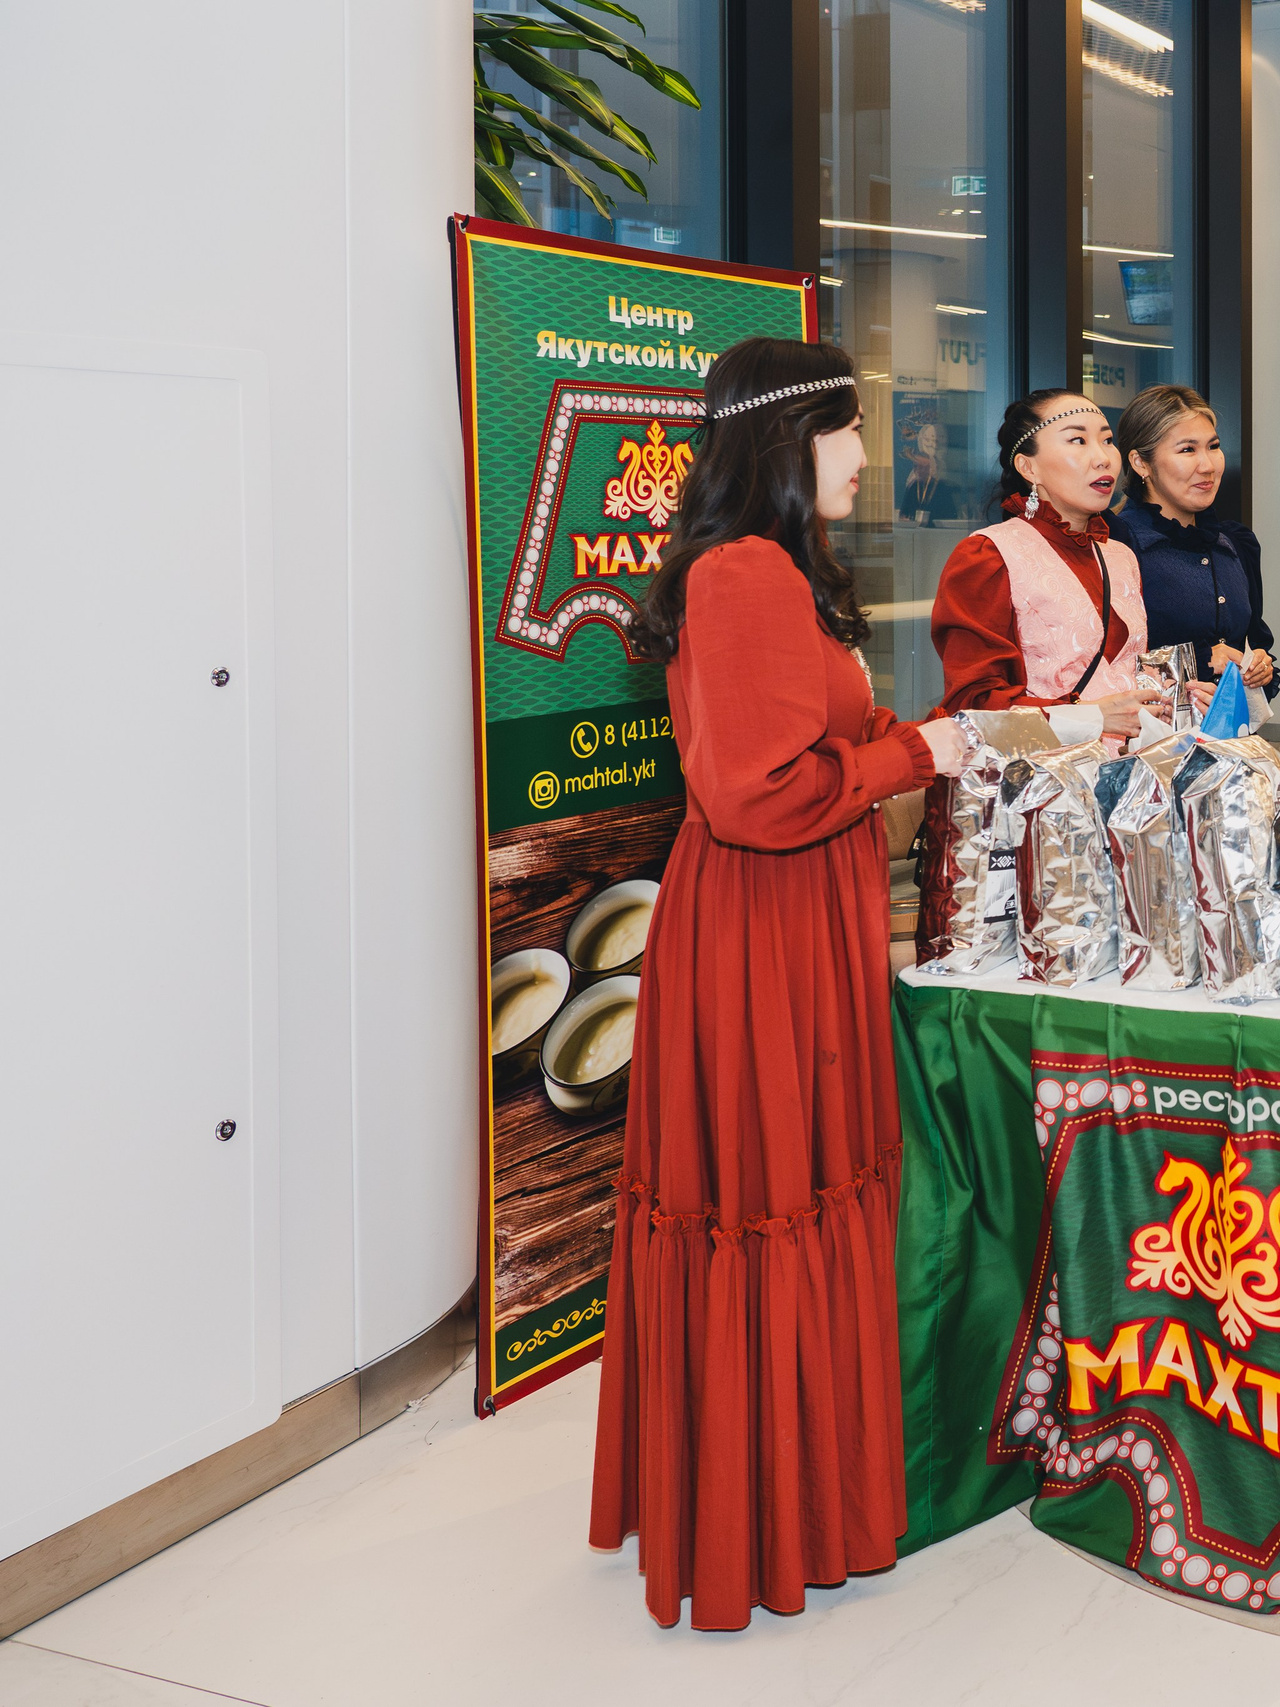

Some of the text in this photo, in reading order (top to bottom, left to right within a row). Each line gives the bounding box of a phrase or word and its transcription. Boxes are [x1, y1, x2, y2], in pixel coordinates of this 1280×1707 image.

[608, 295, 694, 335] Центр
[536, 330, 720, 378] Якутской Ку
[568, 532, 673, 579] МАХ
[604, 724, 616, 746] 8
[564, 758, 656, 794] mahtal.ykt
